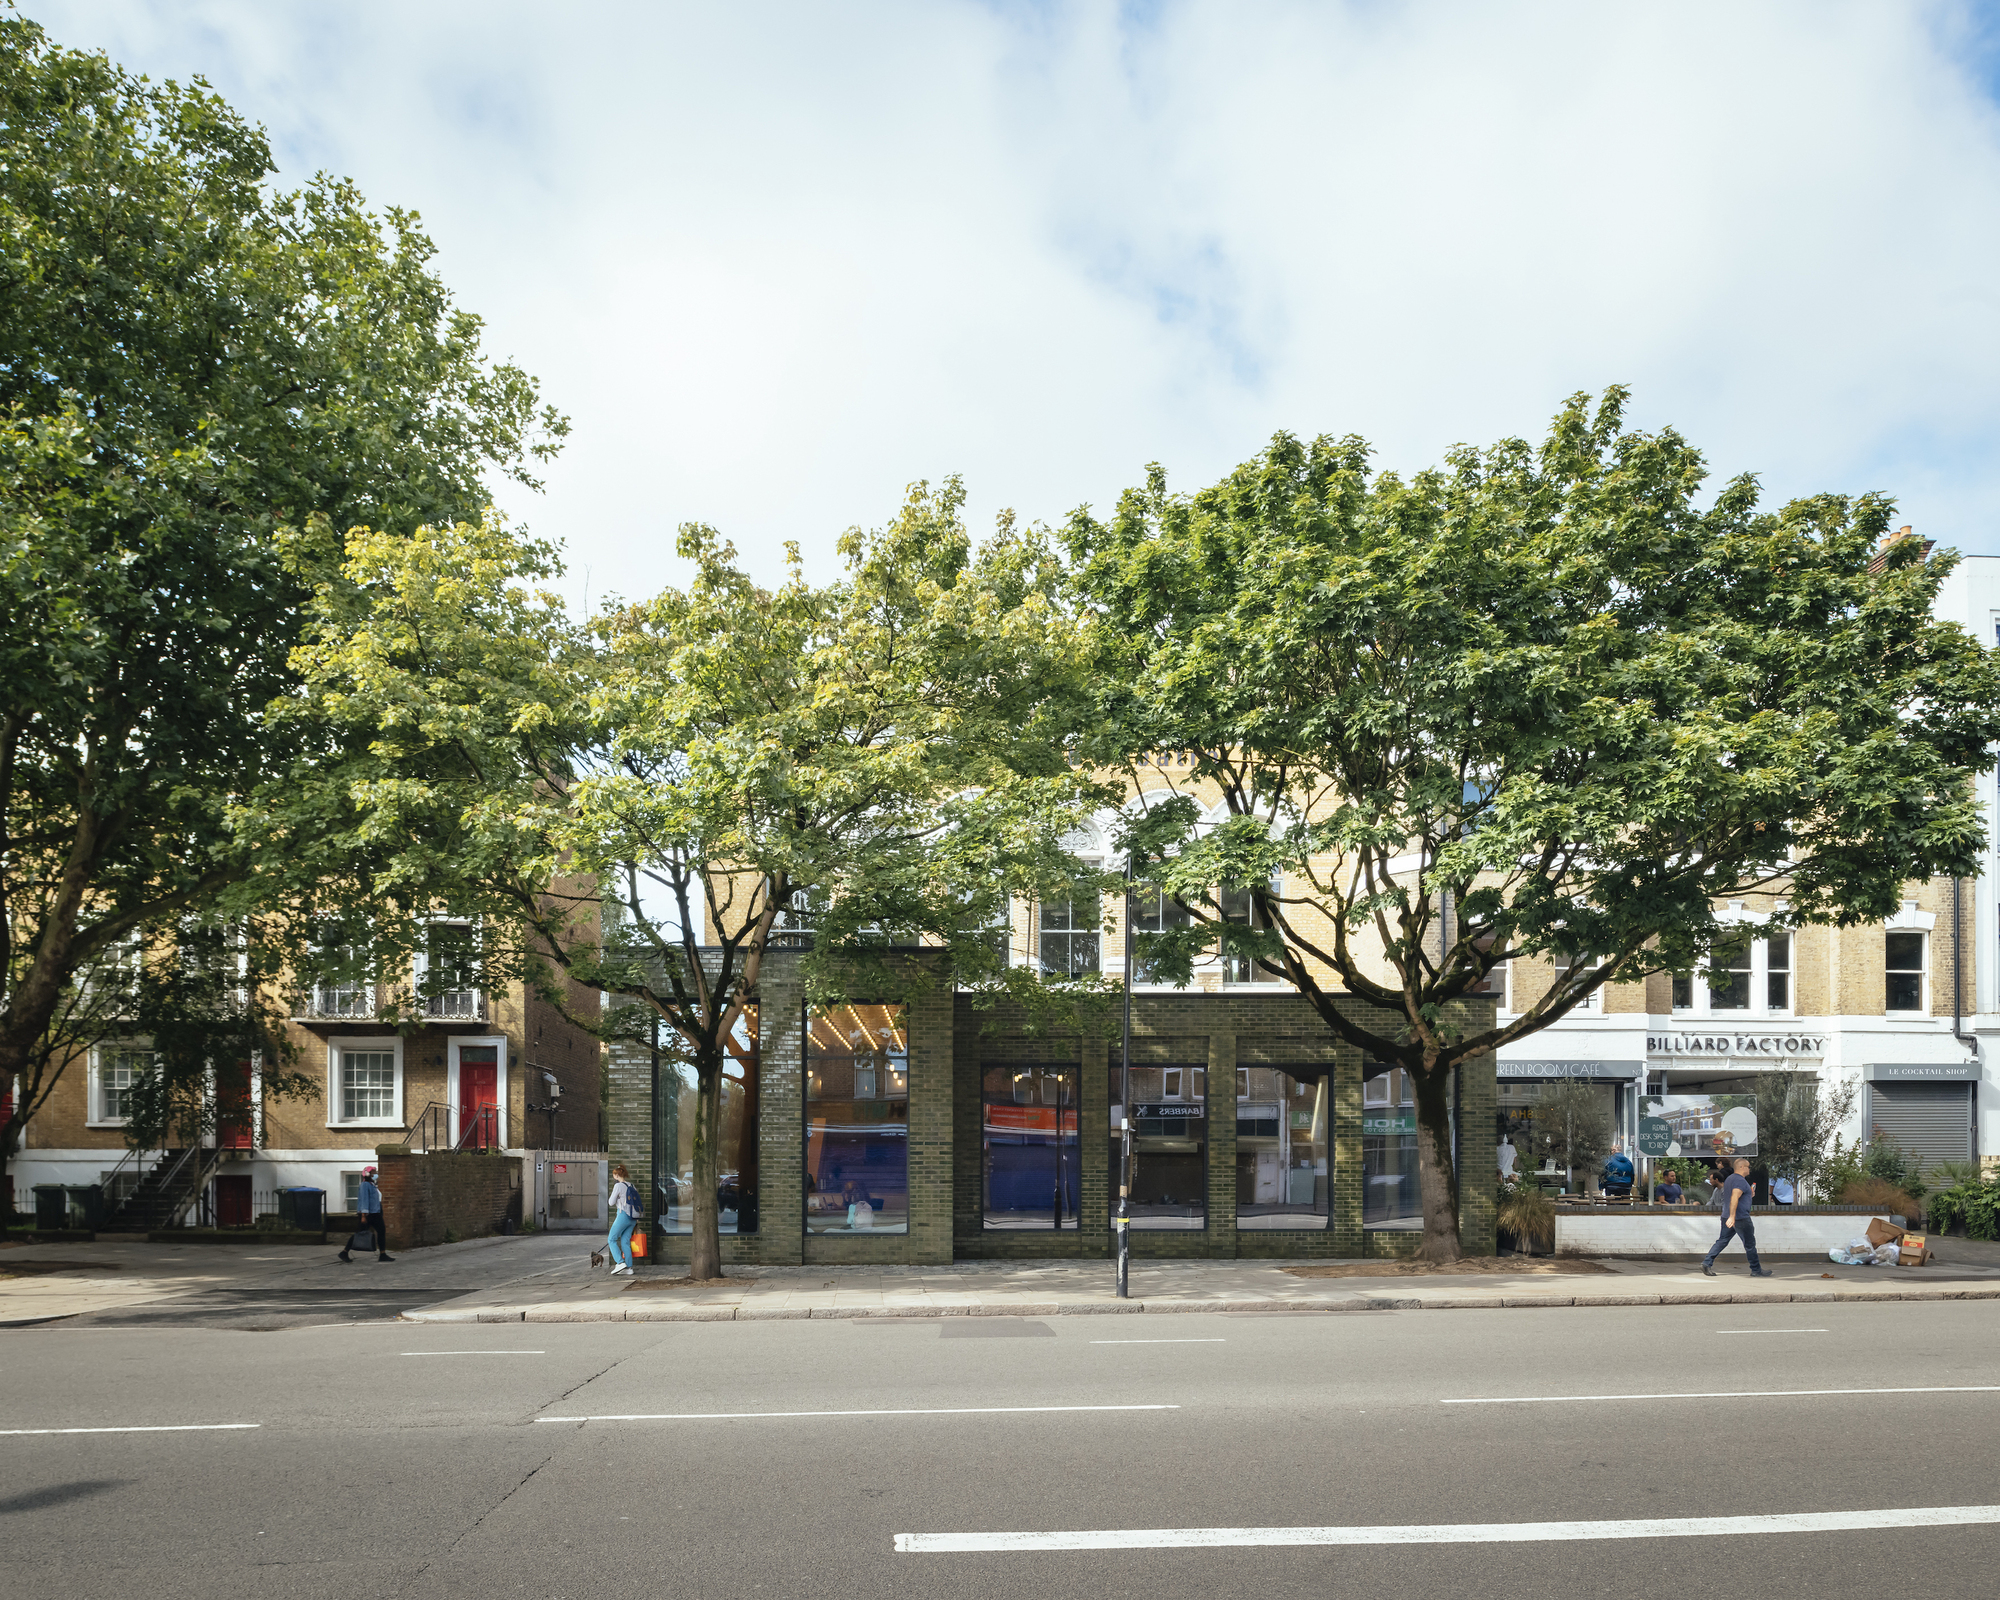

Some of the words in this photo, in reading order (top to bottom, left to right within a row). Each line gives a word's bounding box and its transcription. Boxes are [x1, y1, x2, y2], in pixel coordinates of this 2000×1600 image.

[1646, 1037, 1730, 1051] BILLIARD
[1736, 1037, 1824, 1051] FACTORY
[1527, 1063, 1568, 1076] ROOM
[1570, 1061, 1600, 1076] CAFÉ
[1632, 1068, 1642, 1076] N7
[1901, 1068, 1944, 1076] COCKTAIL
[1640, 1132, 1653, 1140] DESK
[1652, 1132, 1669, 1140] SPACE
[1648, 1141, 1656, 1149] TO
[1656, 1141, 1669, 1149] RENT
